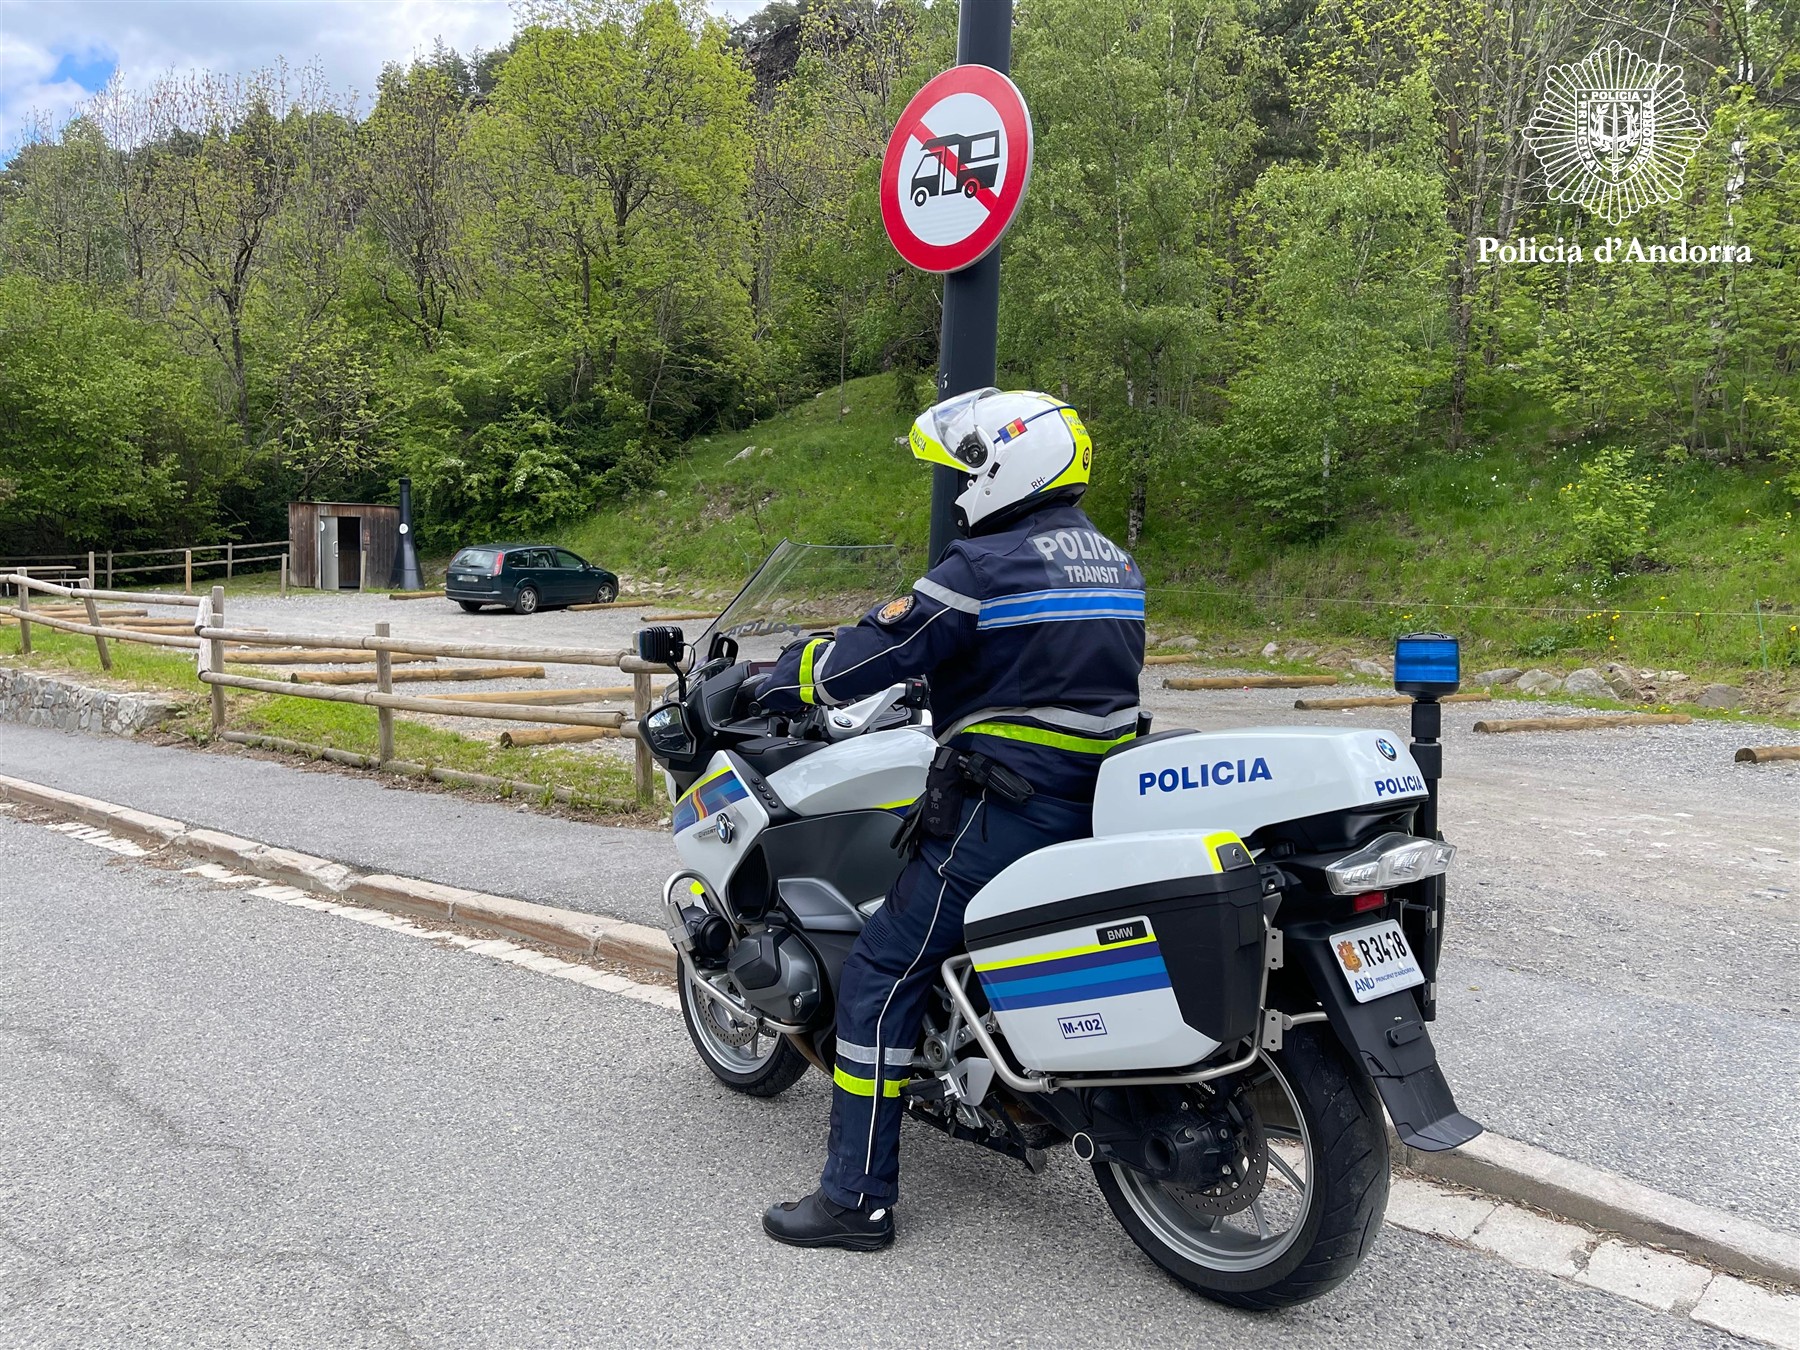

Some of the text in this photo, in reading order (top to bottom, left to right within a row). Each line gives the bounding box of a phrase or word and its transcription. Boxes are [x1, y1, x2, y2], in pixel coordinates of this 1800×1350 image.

[1063, 561, 1120, 584] TRÀNSIT
[1139, 757, 1273, 796] POLICIA
[1374, 775, 1424, 797] POLICIA
[1106, 926, 1134, 941] BMW
[1358, 930, 1407, 967] R3418
[1354, 976, 1375, 994] AND
[1062, 1018, 1103, 1035] M-102
